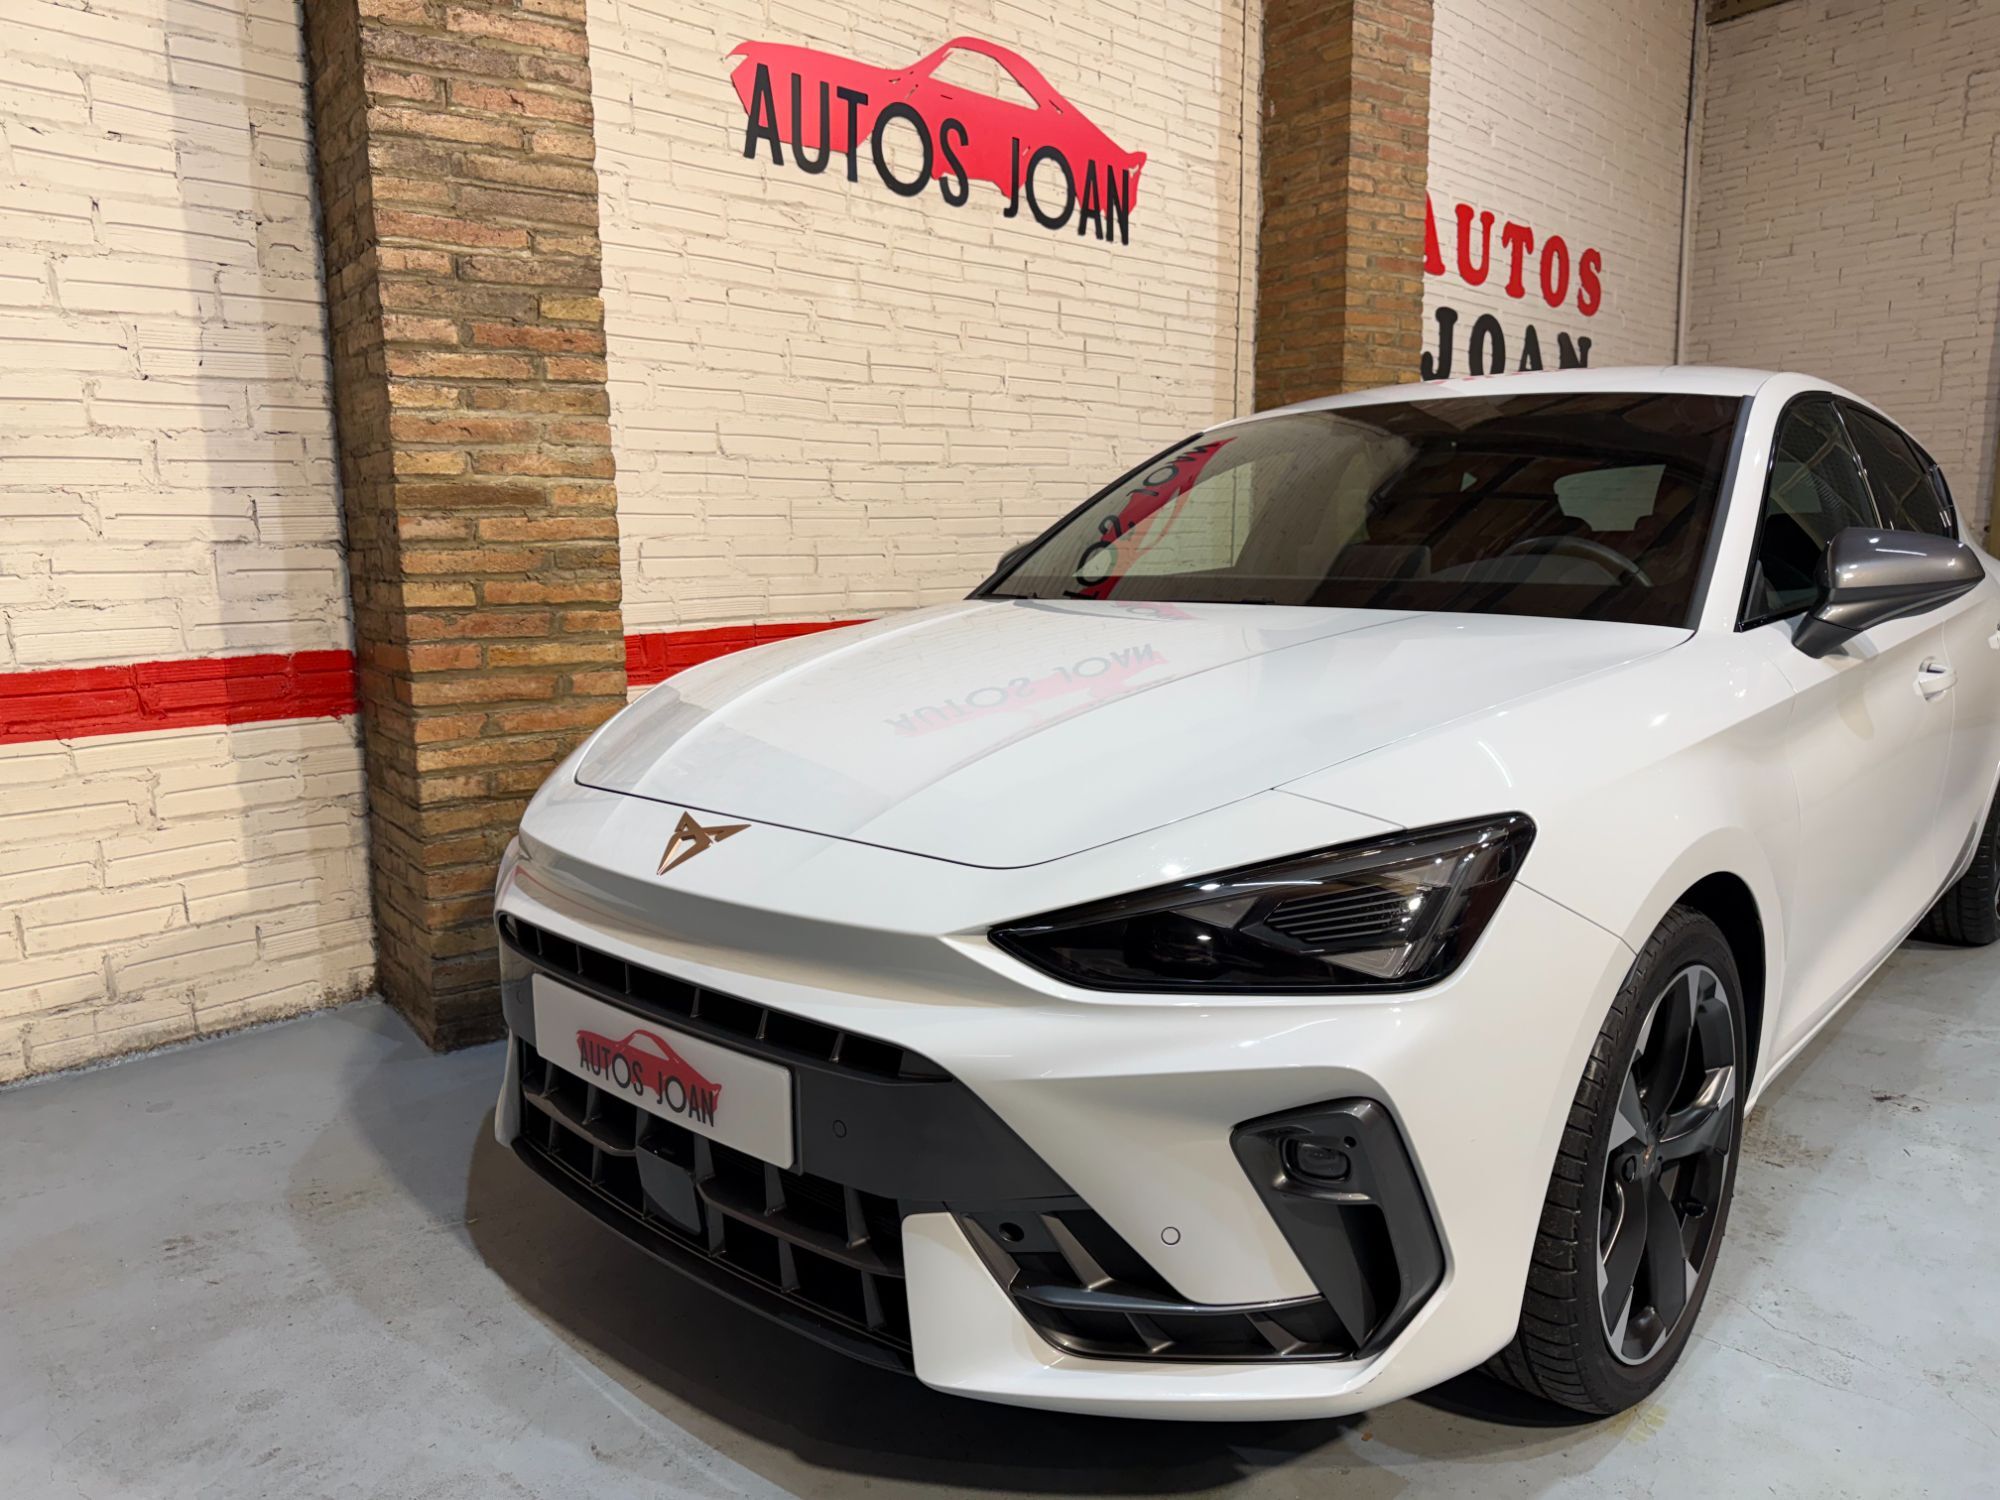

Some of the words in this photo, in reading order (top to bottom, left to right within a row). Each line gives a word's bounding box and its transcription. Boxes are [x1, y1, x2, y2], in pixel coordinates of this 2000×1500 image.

[743, 63, 970, 207] AUTOS
[1003, 137, 1129, 246] JOAN
[580, 1037, 644, 1096] AUTOS
[656, 1071, 714, 1128] JOAN
